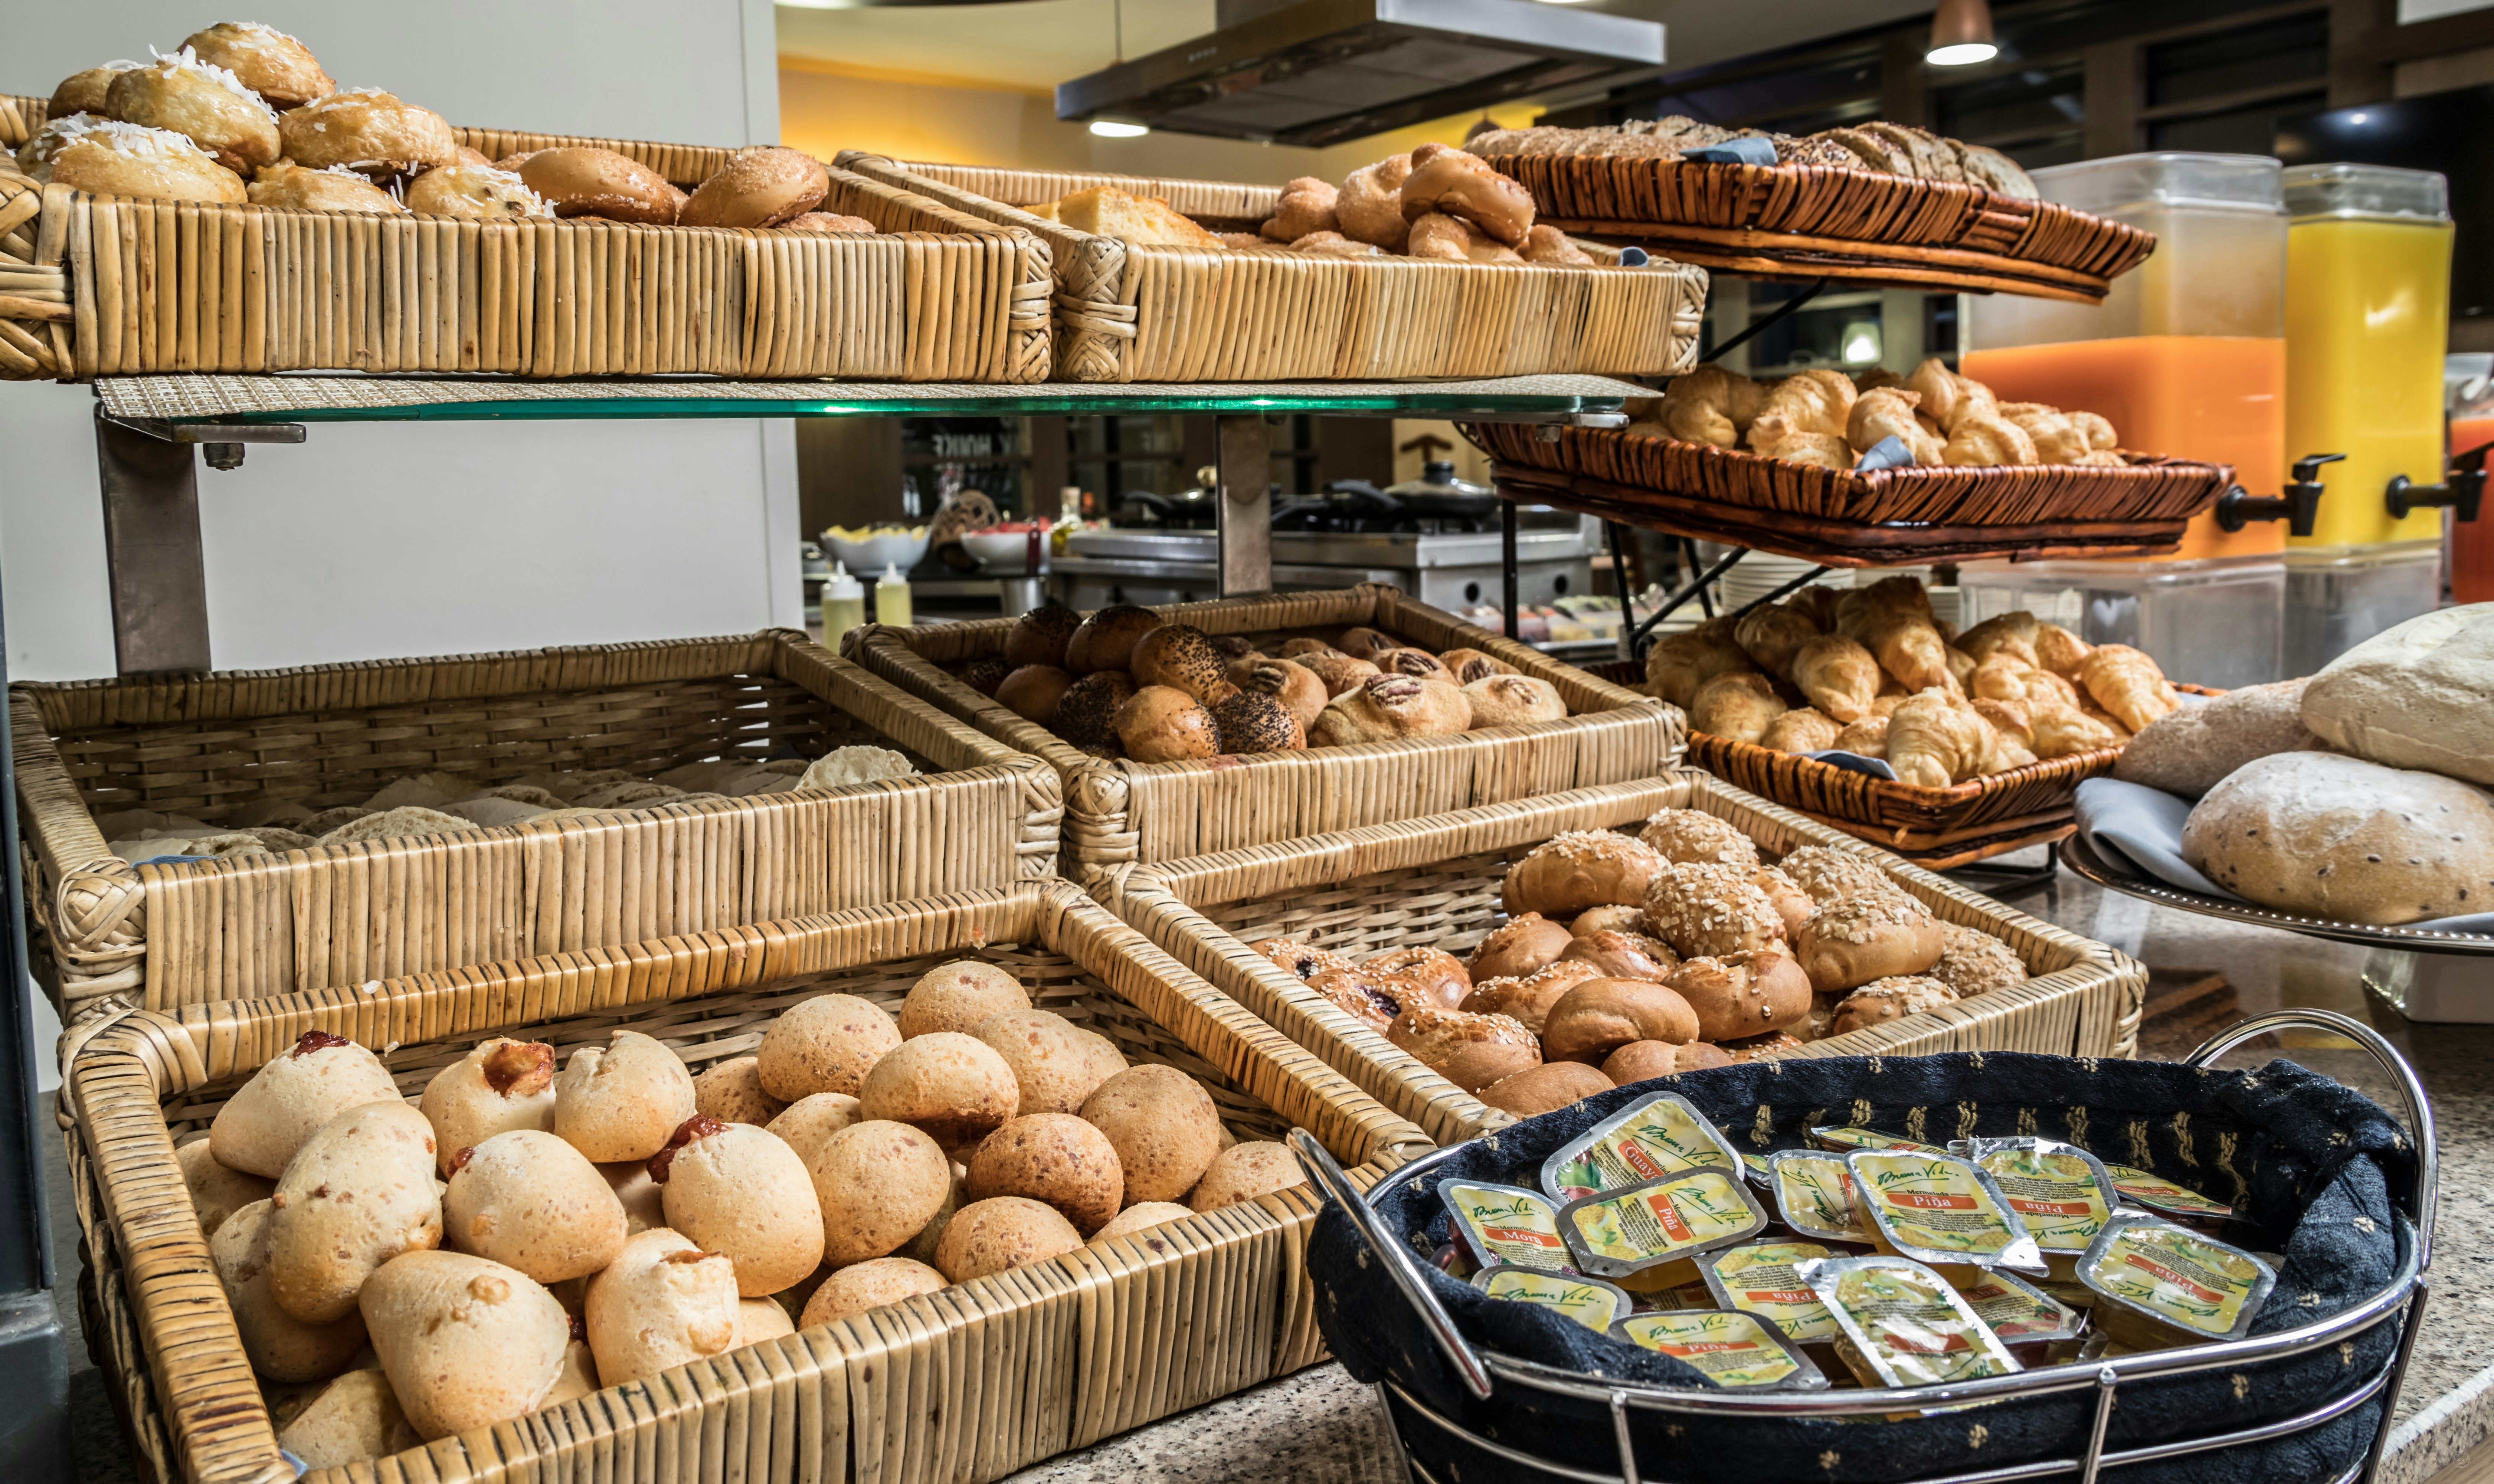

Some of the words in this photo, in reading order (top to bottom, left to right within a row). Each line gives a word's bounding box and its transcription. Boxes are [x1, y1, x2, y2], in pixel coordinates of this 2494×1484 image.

[1643, 1149, 1670, 1176] Mermelad
[1878, 1172, 1922, 1185] Buena
[1912, 1196, 1952, 1208] Piña
[2025, 1202, 2062, 1213] Piña
[1657, 1205, 1680, 1232] Piña
[1671, 1202, 1692, 1228] Mermelada
[1502, 1230, 1542, 1245] Mora
[2155, 1266, 2194, 1291] Piña
[1771, 1291, 1810, 1300] Piña
